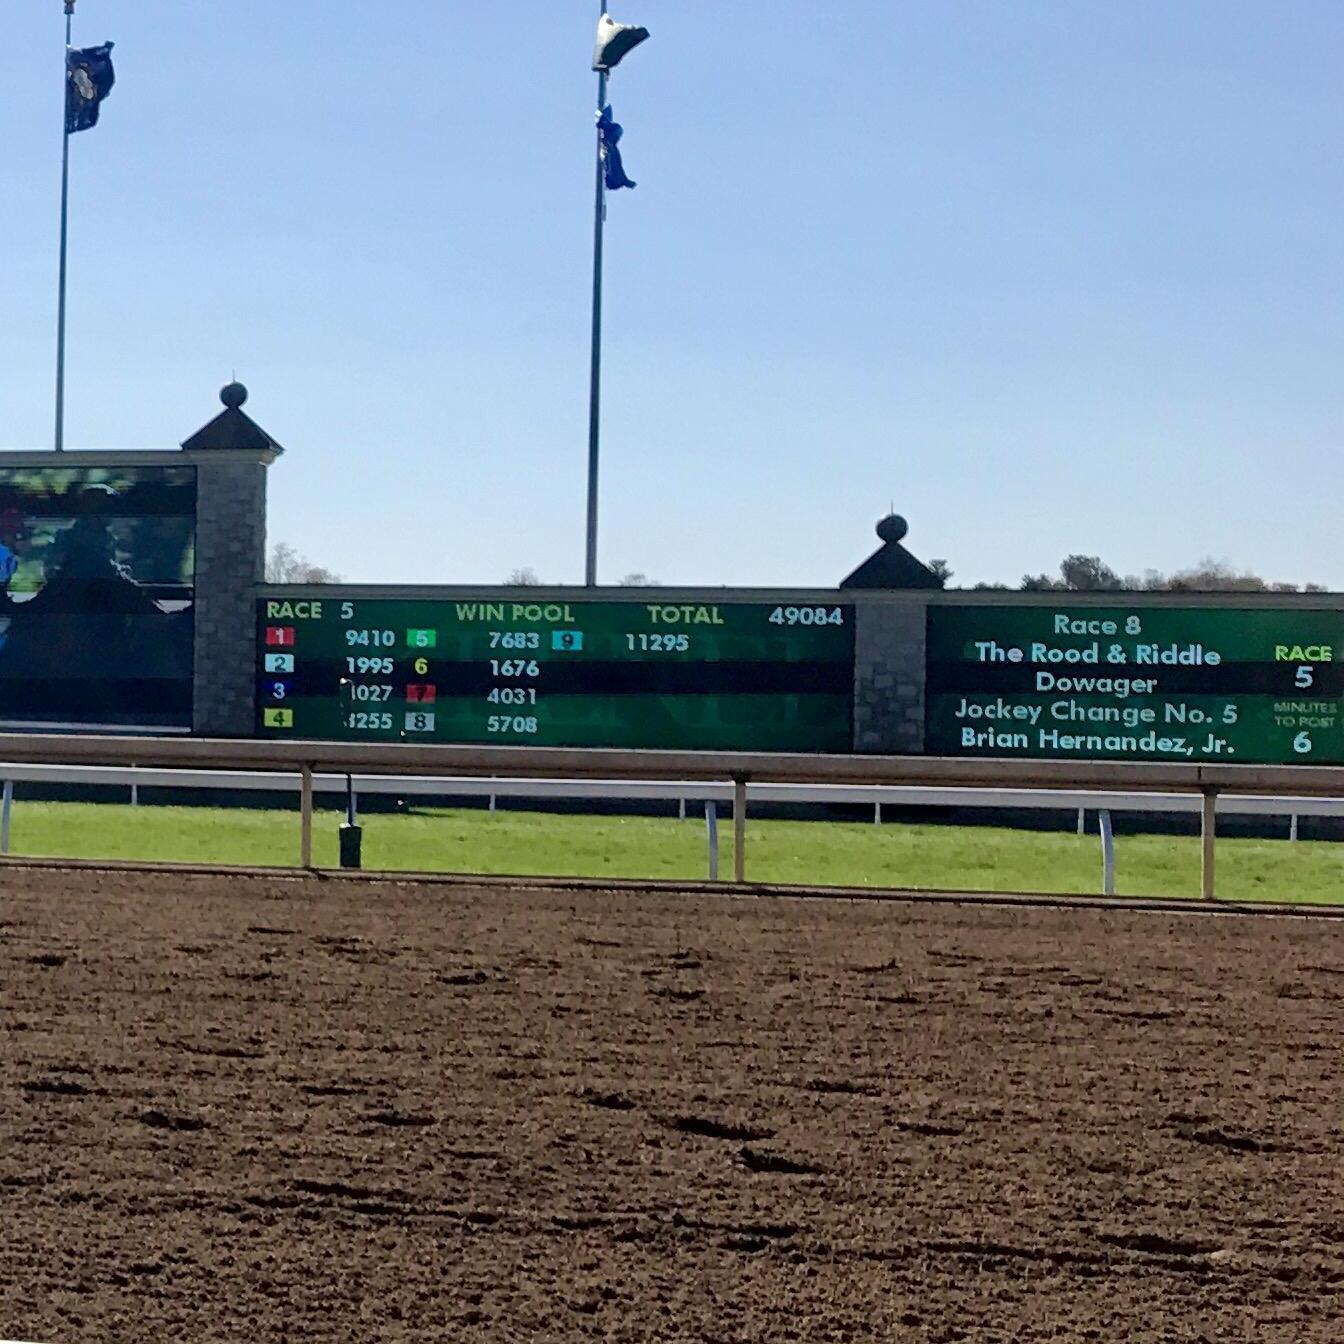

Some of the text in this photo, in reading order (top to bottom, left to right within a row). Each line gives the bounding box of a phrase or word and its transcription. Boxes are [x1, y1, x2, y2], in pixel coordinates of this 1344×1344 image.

[267, 601, 844, 626] RACE 5 WIN POOL TOTAL 49084
[1054, 614, 1142, 635] Race 8
[345, 630, 395, 646] 9410
[416, 630, 428, 646] 5
[489, 632, 540, 649] 7683
[561, 634, 574, 648] 9
[626, 634, 690, 652] 11295
[974, 641, 1221, 666] The Rood & Riddle
[1275, 645, 1333, 662] RACE
[274, 657, 540, 677] 2 1995 6 1676
[1294, 665, 1314, 689] 5
[273, 682, 536, 705] 3 1027 7 4031
[1036, 671, 1158, 698] Dowager
[273, 711, 285, 726] 4
[414, 714, 426, 729] 8
[487, 716, 538, 733] 5708
[955, 698, 1238, 727] Jockey Change No. 5
[1274, 716, 1335, 728] TO POST
[962, 726, 1235, 756] Brian Hernandez, Jr.
[1293, 731, 1312, 753] 6
